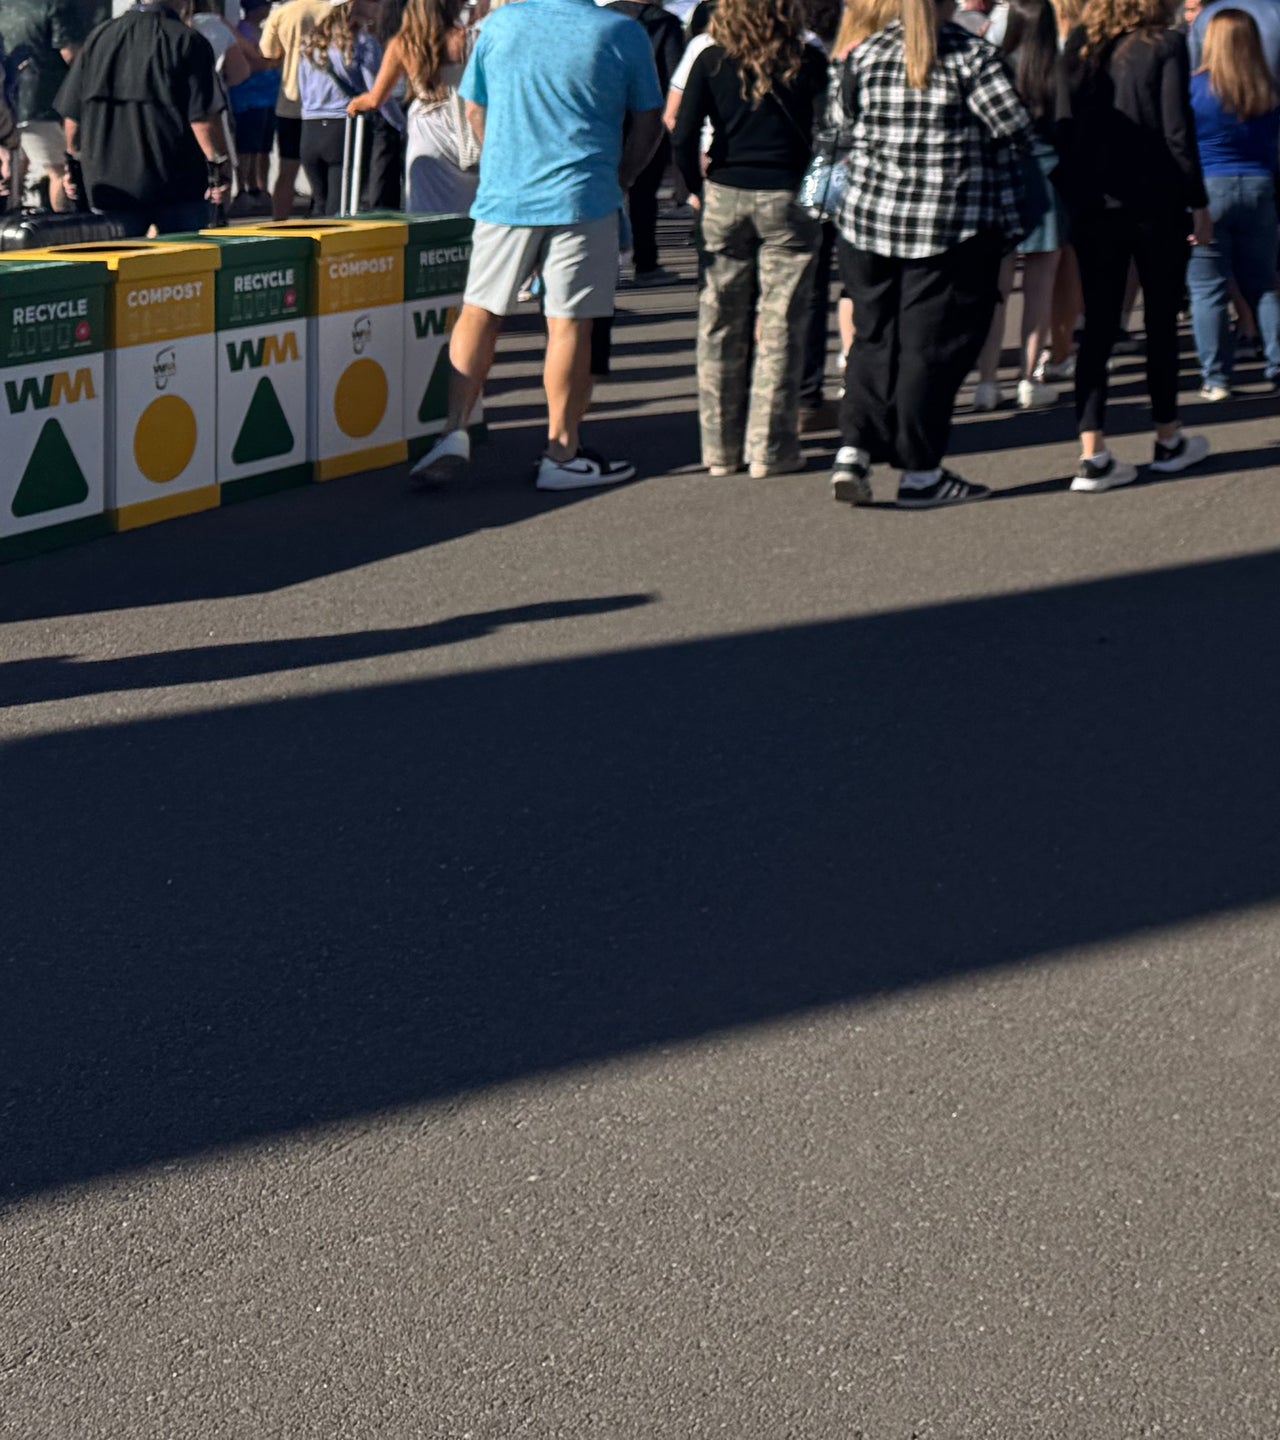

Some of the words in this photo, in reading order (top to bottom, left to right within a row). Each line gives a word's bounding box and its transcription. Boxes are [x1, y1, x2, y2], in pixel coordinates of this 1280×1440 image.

[233, 268, 295, 293] RECYCLE
[328, 255, 395, 280] COMPOST
[127, 280, 204, 308] COMPOST
[13, 298, 89, 326] RECYCLE
[226, 330, 299, 372] WM
[4, 367, 96, 414] WM
